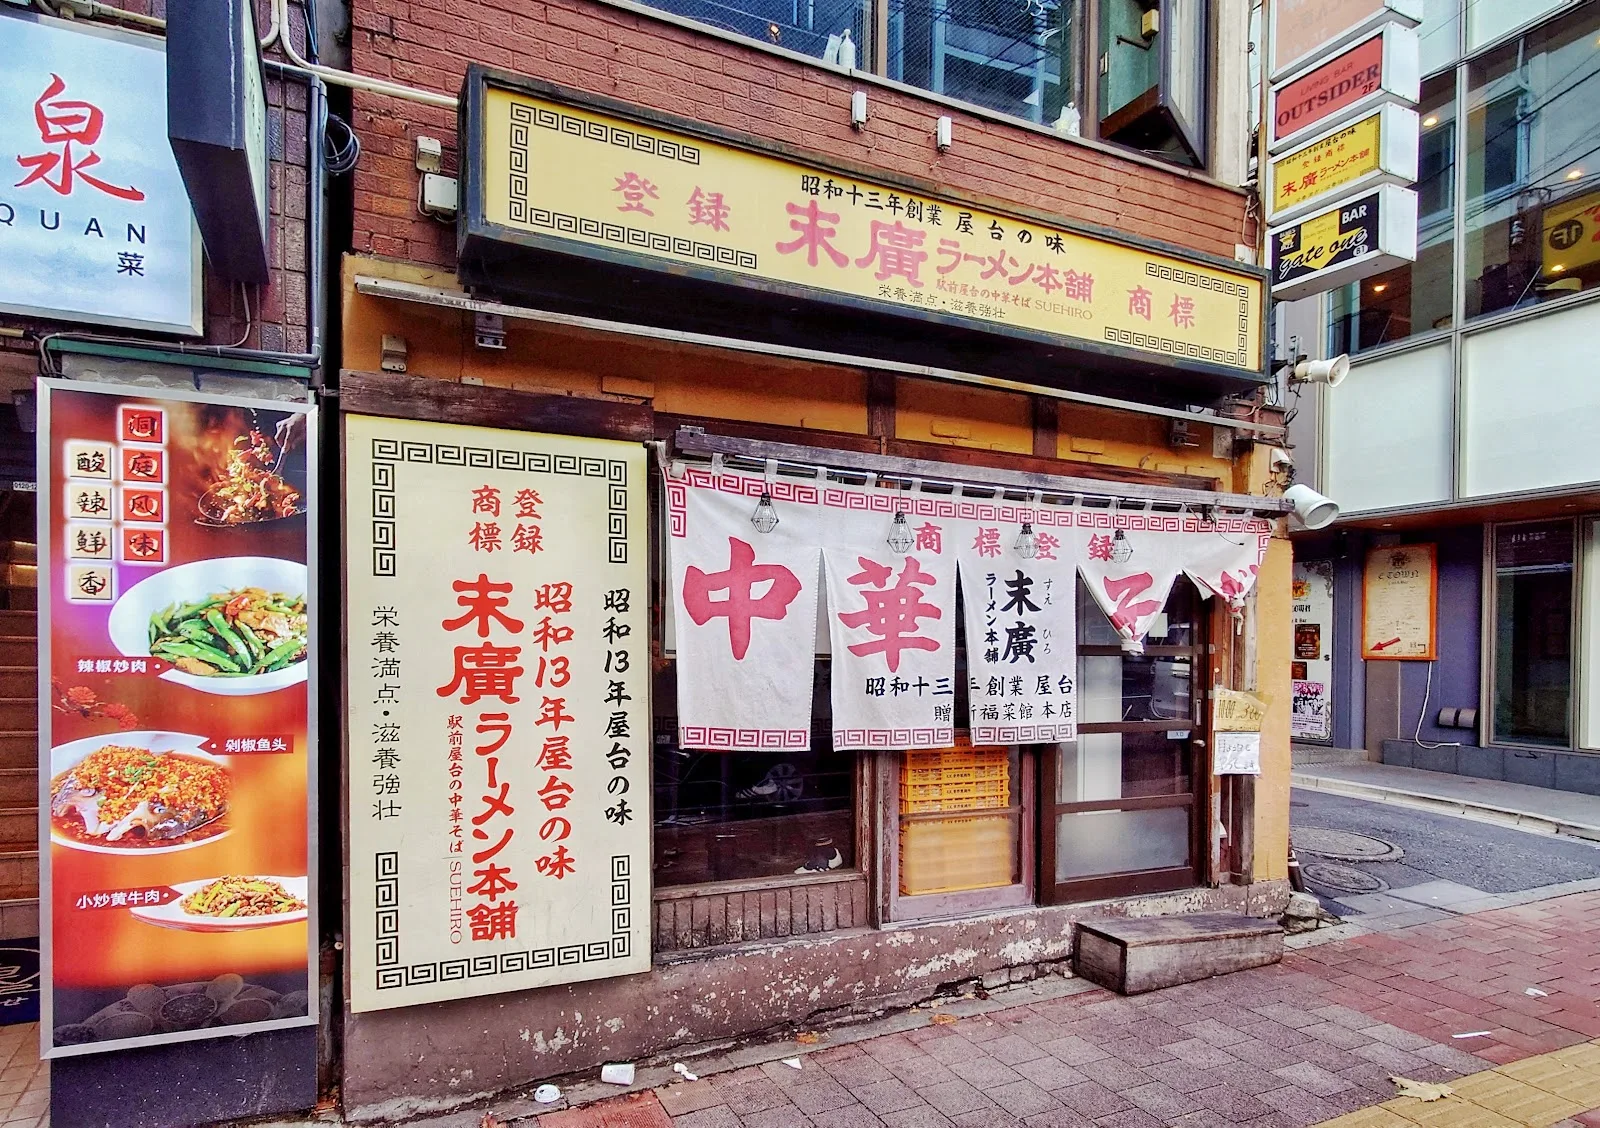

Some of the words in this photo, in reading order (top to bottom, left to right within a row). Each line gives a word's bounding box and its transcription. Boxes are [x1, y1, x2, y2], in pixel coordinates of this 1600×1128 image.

[1278, 63, 1379, 127] OUTSIDER
[1334, 62, 1353, 77] BAR
[1361, 81, 1375, 96] 2F
[14, 72, 145, 202] 泉
[0, 203, 146, 245] QUAN
[612, 170, 732, 234] 登録
[801, 173, 943, 227] 昭和十三年創業
[955, 211, 1067, 256] 屋台の味
[1341, 204, 1368, 225] BAR
[116, 251, 145, 277] 菜
[776, 199, 1095, 304] 末廣ラーメン本舗
[1278, 246, 1326, 280] gate
[1328, 227, 1369, 254] one
[1034, 299, 1094, 321] SUEHIRO
[1126, 283, 1197, 331] 商標
[128, 414, 159, 558] 洞庭风味
[468, 484, 503, 554] 商標
[510, 487, 545, 556] 登録
[983, 573, 1000, 664] ラーメン本舗
[1000, 569, 1042, 664] 末廣
[1292, 604, 1311, 613] OWN
[77, 658, 147, 674] 辣椒炒肉
[370, 605, 402, 821] 栄養満点・滋養強壮
[533, 581, 576, 880] 昭和13年屋台の味
[602, 588, 633, 826] 昭和13年屋台の味
[1040, 701, 1073, 721] 本店
[224, 736, 288, 753] 剁椒鱼头
[436, 573, 525, 941] 末廣ラーメン本舗
[446, 714, 464, 853] 駅前屋台の中華そば
[76, 888, 161, 909] 小炒黄牛肉
[449, 861, 462, 945] SUEHIRO
